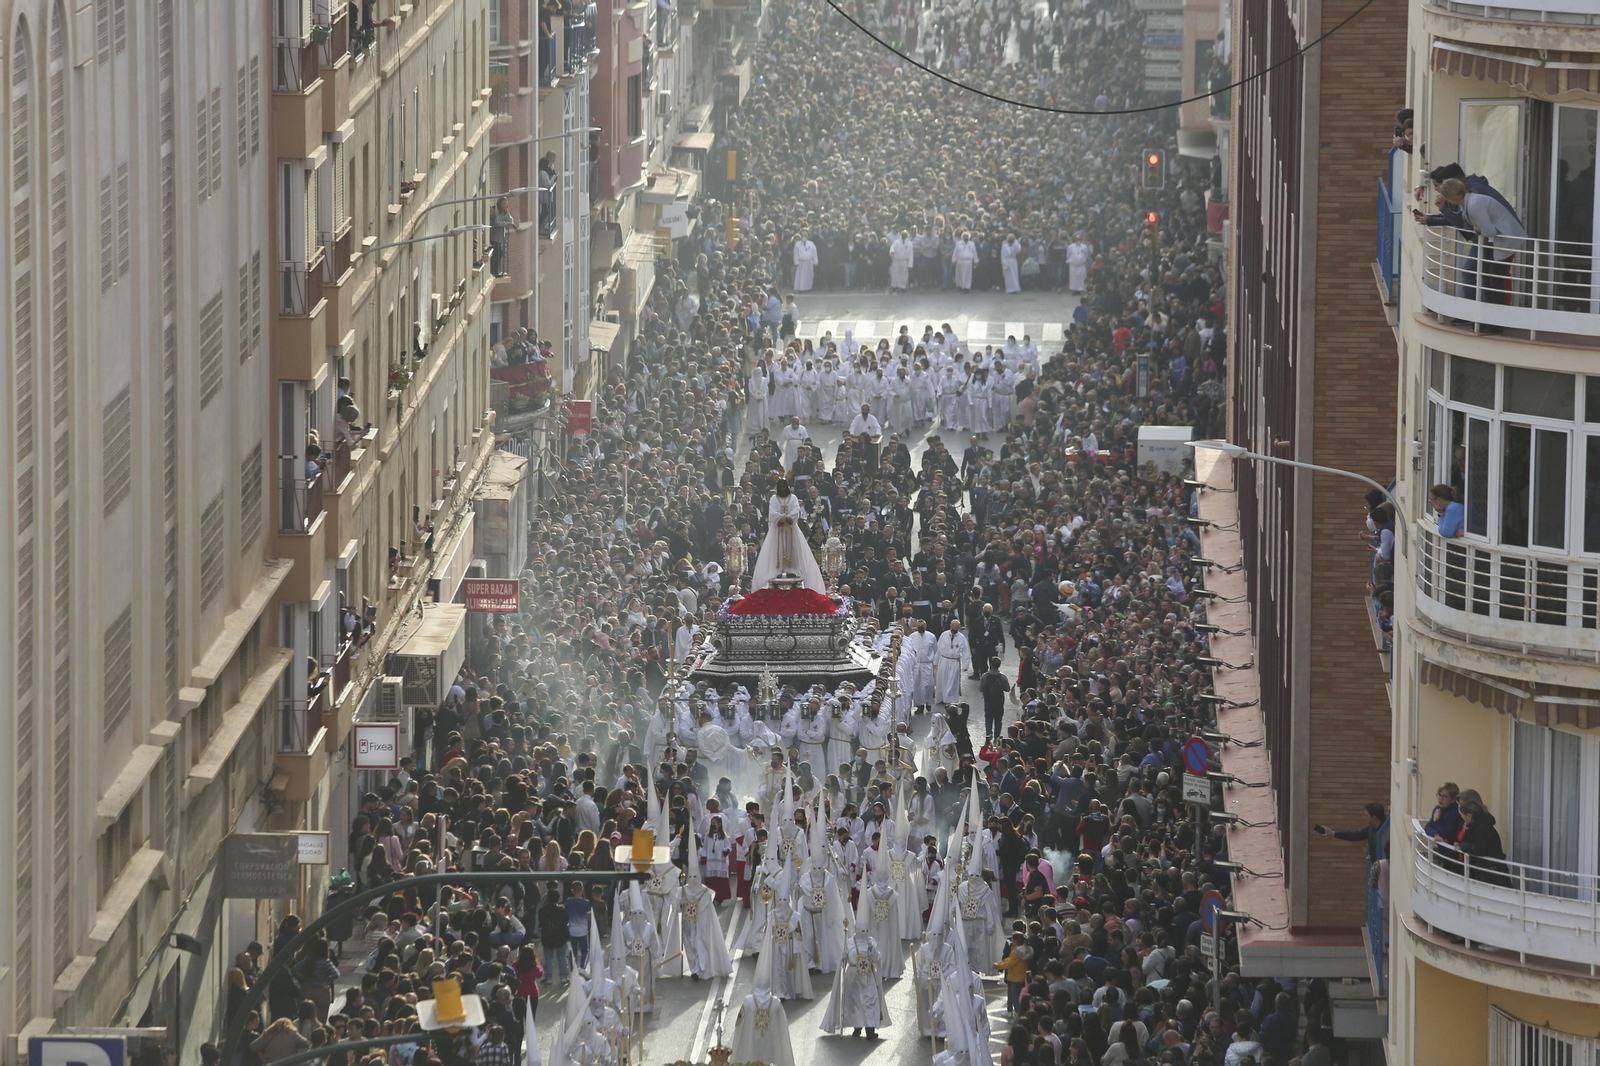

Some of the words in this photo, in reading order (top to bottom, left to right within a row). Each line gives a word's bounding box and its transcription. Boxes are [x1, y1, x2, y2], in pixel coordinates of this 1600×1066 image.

[467, 584, 489, 594] SUPER
[490, 584, 513, 595] BAZAR
[369, 742, 393, 751] Fixea
